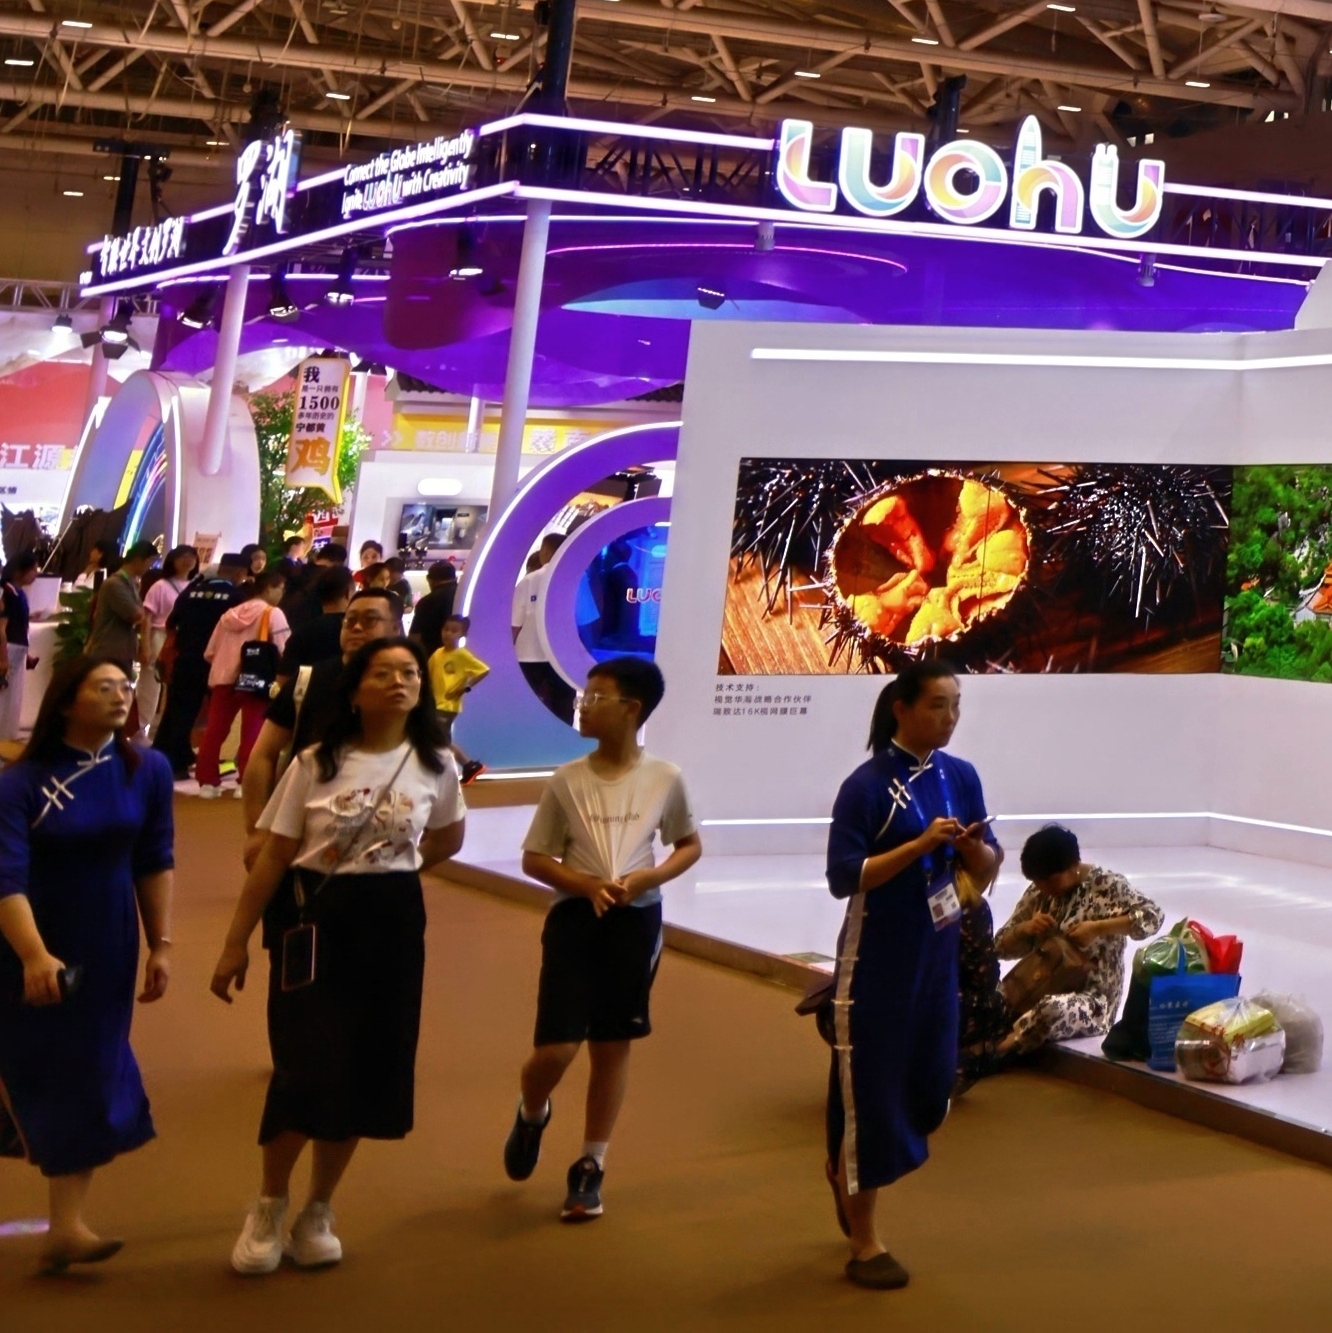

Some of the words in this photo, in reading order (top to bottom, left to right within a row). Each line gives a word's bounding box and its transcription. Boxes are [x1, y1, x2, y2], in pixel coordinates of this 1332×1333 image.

[390, 145, 417, 171] Globe
[423, 160, 470, 190] Creativity
[303, 366, 320, 383] 我
[299, 396, 340, 410] 1500
[0, 442, 80, 470] 江源
[290, 436, 332, 476] 鸡
[626, 588, 662, 603] LUO
